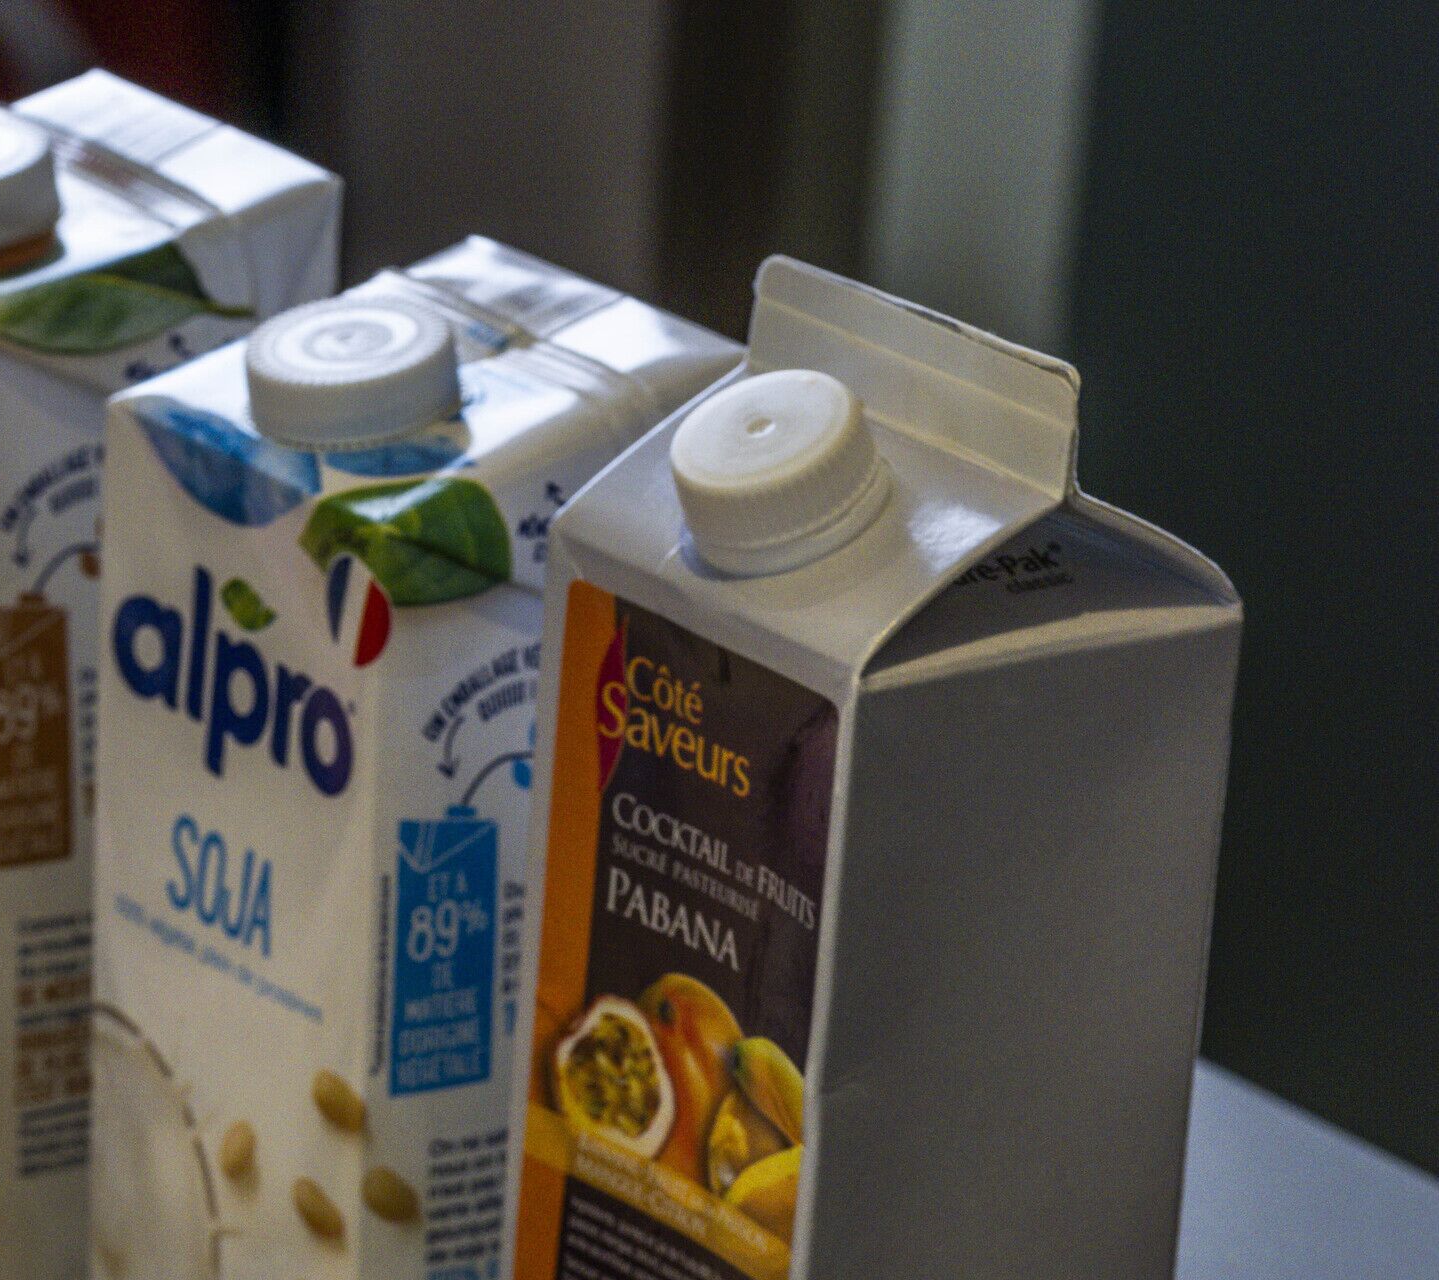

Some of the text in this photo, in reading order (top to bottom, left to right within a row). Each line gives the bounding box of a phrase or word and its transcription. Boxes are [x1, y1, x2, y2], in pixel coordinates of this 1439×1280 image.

[110, 565, 354, 796] alpro
[627, 656, 703, 725] Côté
[599, 681, 750, 798] Saveurs
[166, 815, 271, 957] SOJA
[407, 898, 489, 963] 89%
[606, 866, 740, 972] PABANA
